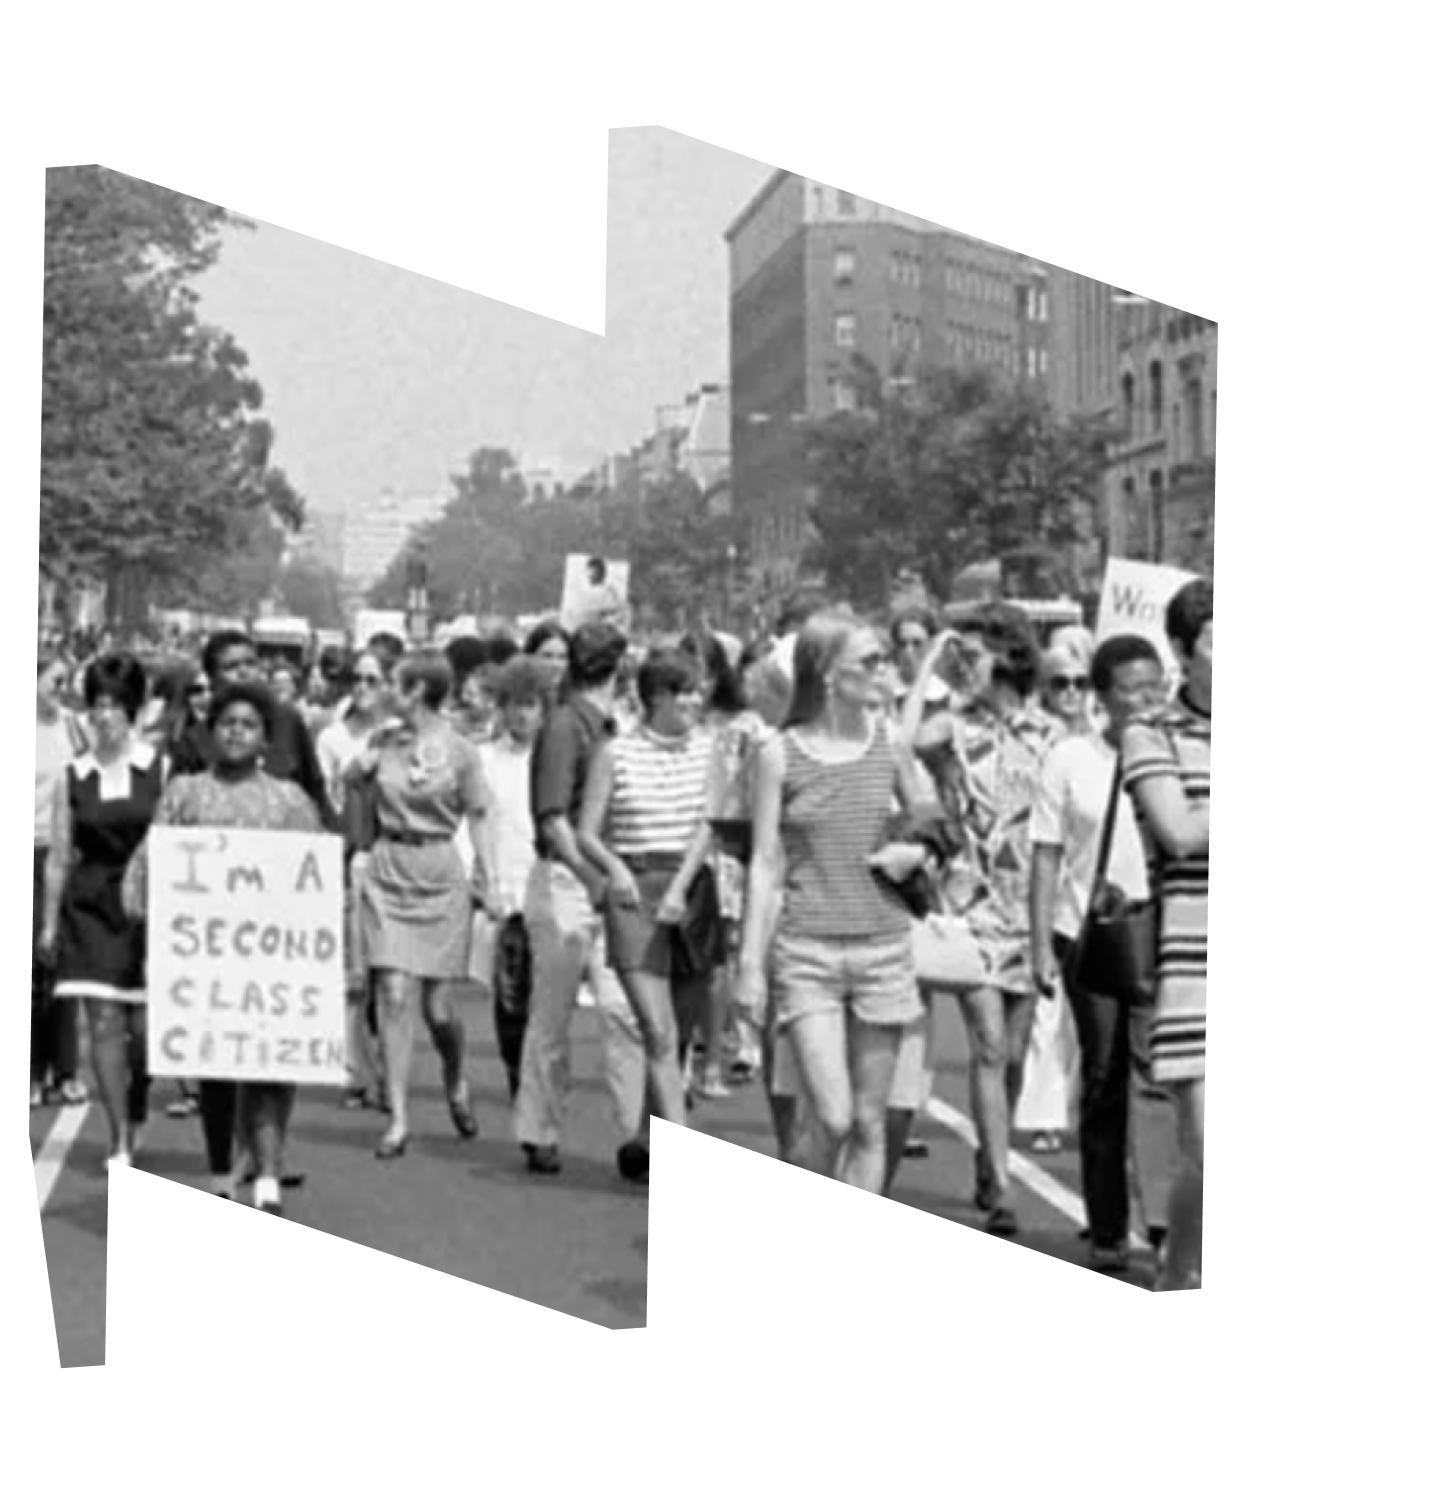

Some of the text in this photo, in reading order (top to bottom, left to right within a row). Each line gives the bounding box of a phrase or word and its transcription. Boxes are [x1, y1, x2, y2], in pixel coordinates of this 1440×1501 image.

[1111, 582, 1156, 620] Wo
[295, 850, 323, 892] A
[170, 912, 337, 962] SECOND
[169, 976, 321, 1017] CLASS
[160, 1019, 344, 1067] CITIZEN
